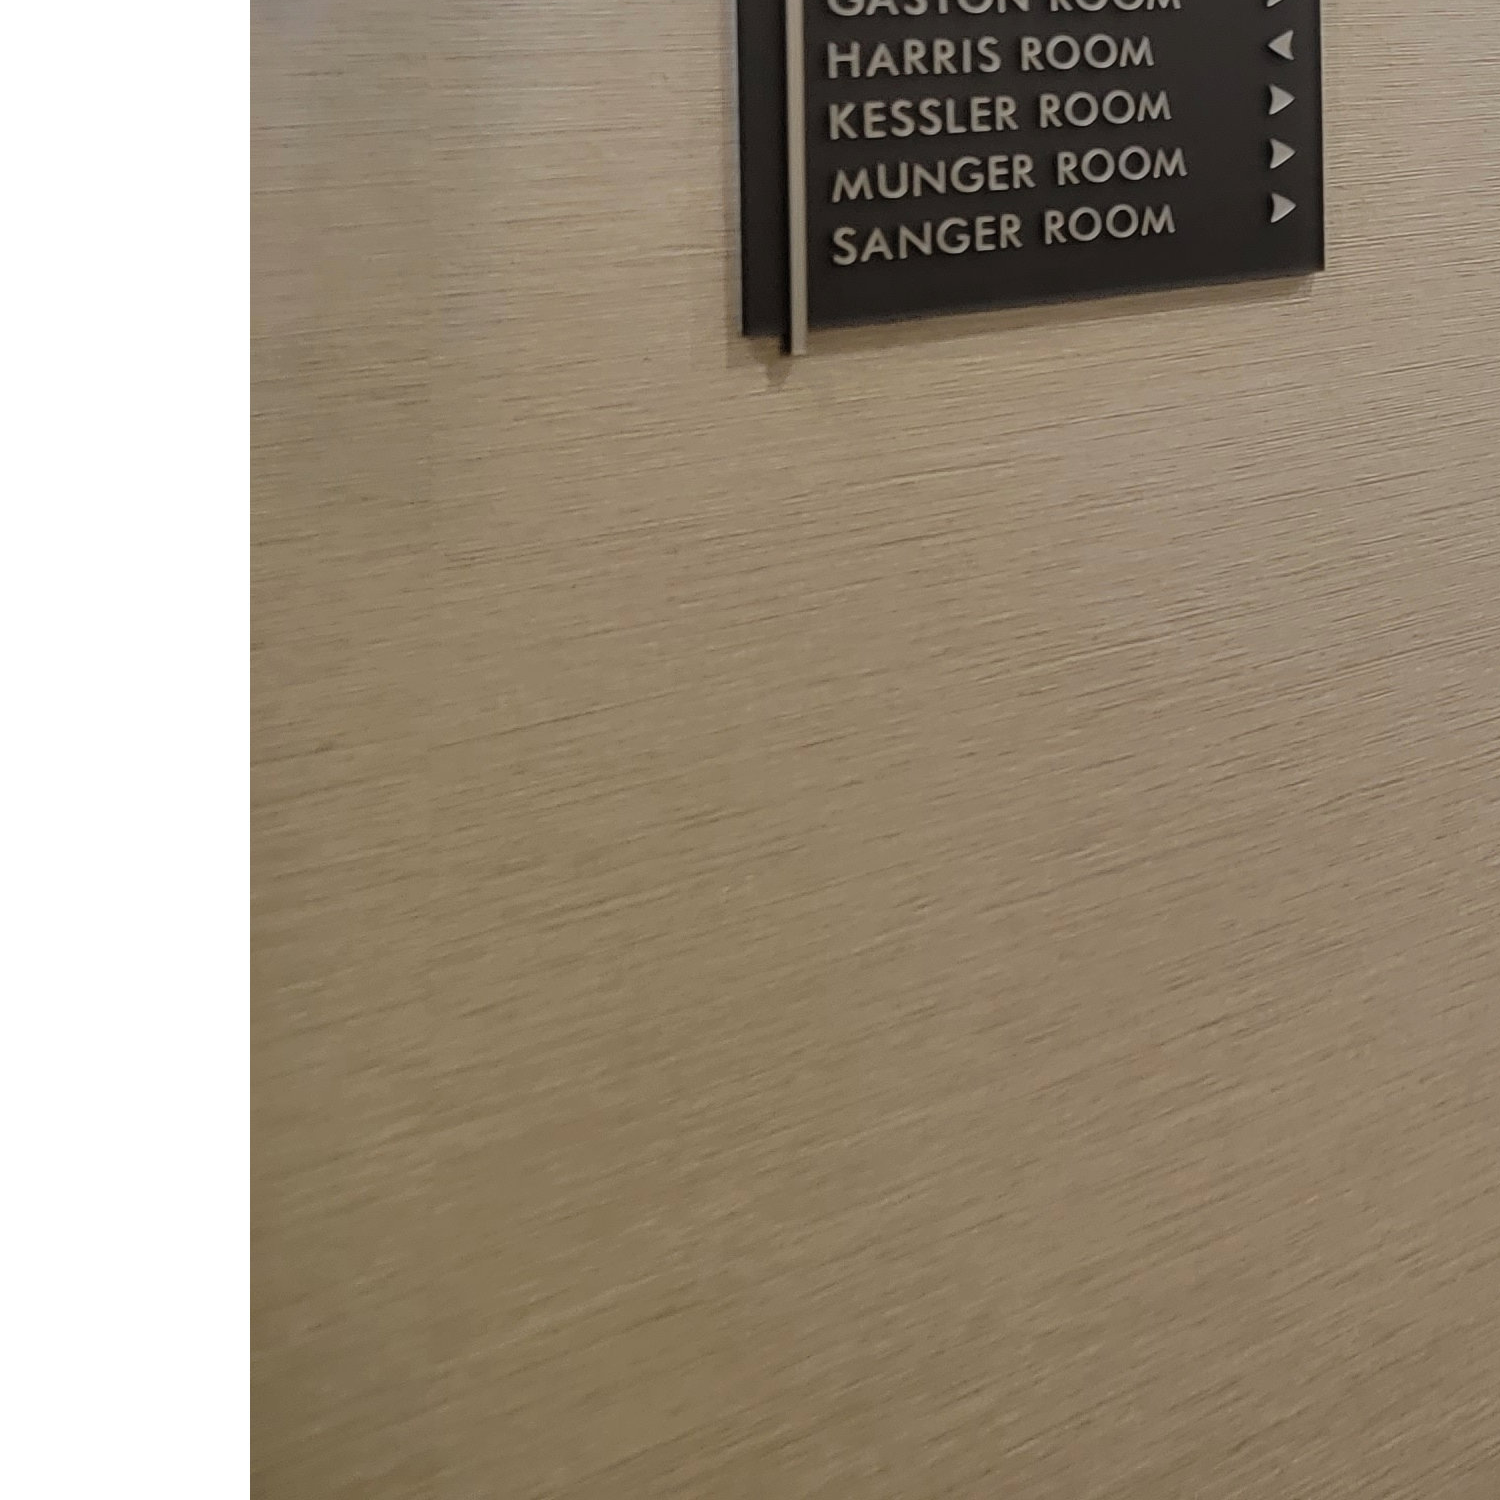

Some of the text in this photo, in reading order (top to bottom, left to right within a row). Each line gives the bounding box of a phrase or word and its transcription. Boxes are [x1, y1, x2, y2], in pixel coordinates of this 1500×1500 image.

[828, 33, 1155, 79] HARRIS ROOM
[829, 89, 1173, 140] KESSLER ROOM
[833, 146, 1188, 203] MUNGER ROOM
[833, 204, 1176, 265] SANGER ROOM
